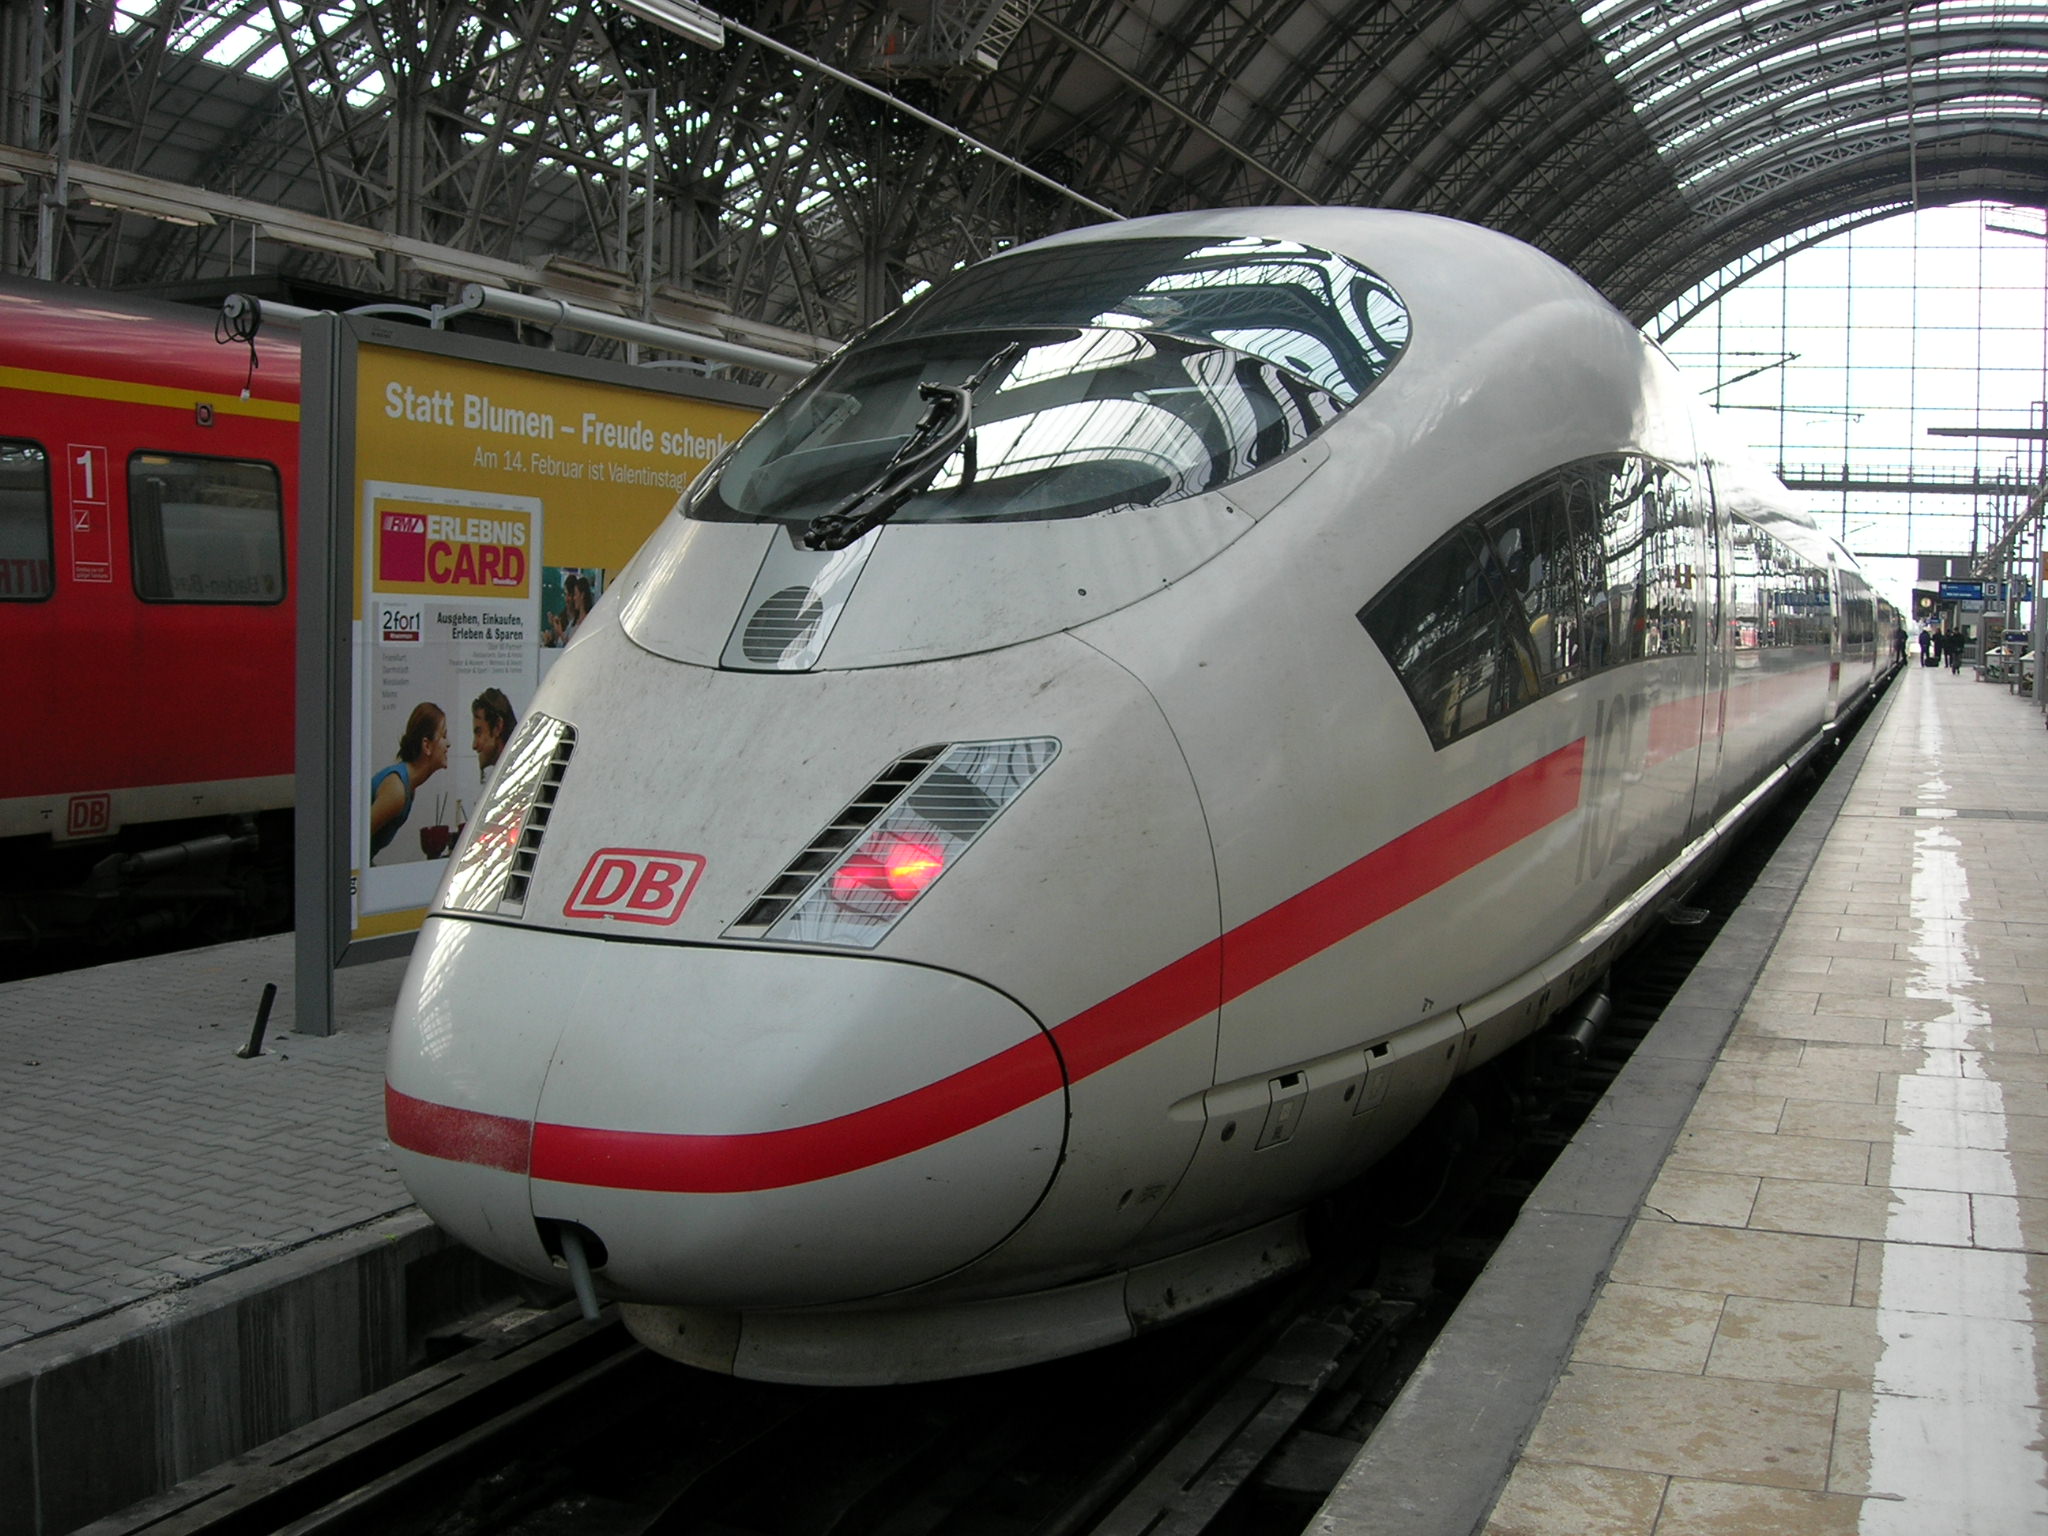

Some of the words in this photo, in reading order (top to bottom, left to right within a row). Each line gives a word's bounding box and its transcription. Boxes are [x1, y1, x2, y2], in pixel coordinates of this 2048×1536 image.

[385, 381, 454, 427] Statt
[464, 394, 553, 440] Blumen
[582, 412, 654, 452] Freude
[76, 450, 93, 499] 1
[473, 446, 498, 469] Am
[503, 450, 527, 472] 14.
[531, 453, 583, 480] Februar
[588, 462, 604, 480] ist
[609, 462, 687, 493] Valentinstag!
[428, 515, 526, 546] ERLEBNIS
[427, 540, 526, 587] CARD
[1987, 584, 1996, 594] B
[383, 610, 421, 630] 2for1
[437, 612, 480, 626] Ausgehen,
[483, 613, 524, 627] Einkaufen,
[452, 627, 484, 640] Erleben
[485, 628, 493, 640] &
[495, 628, 524, 641] Sparen
[73, 801, 105, 828] DB
[580, 859, 683, 911] DB
